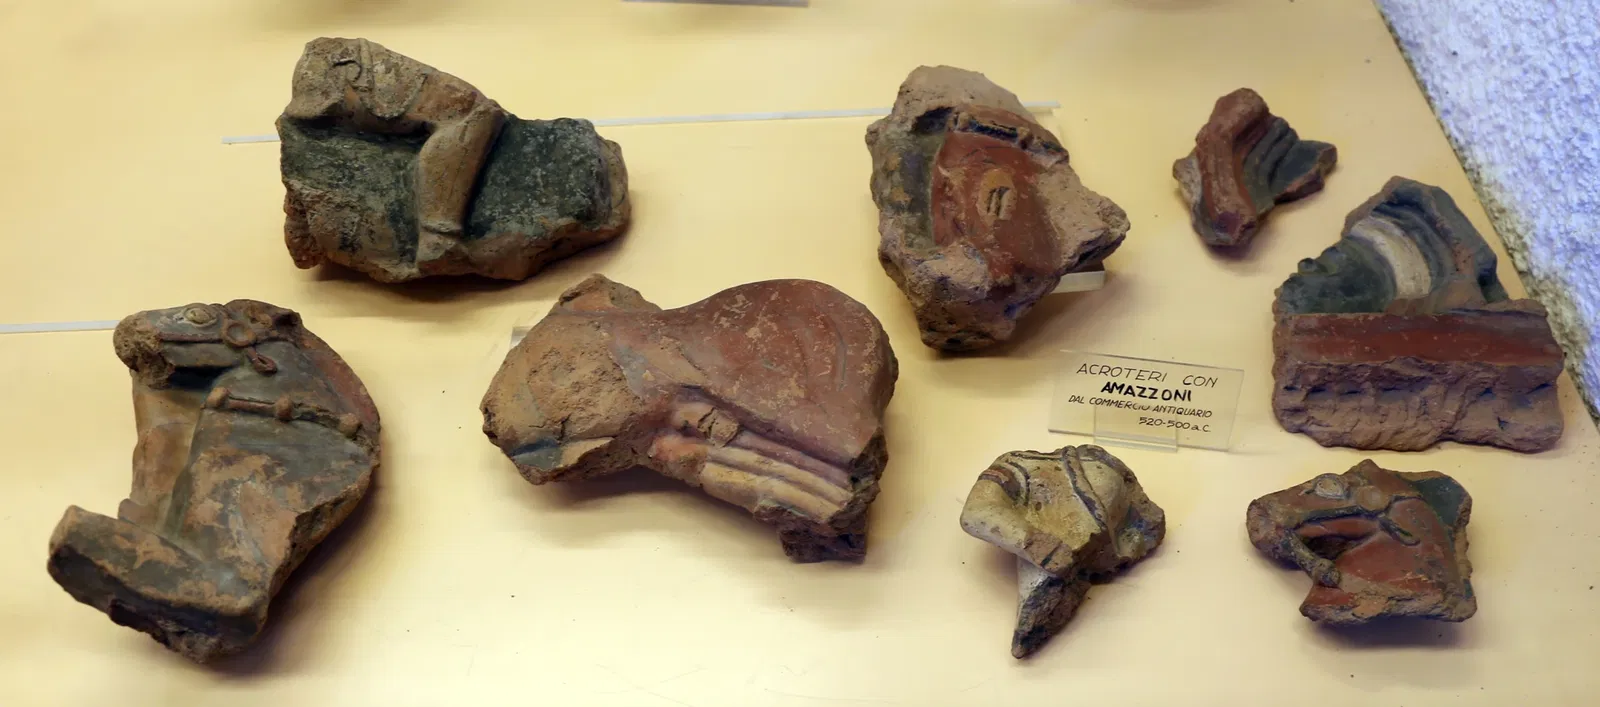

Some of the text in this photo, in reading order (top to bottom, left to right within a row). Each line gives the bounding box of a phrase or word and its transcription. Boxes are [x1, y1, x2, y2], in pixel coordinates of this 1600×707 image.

[1076, 363, 1218, 388] ACROTERI CON
[1100, 381, 1192, 402] AMAZZONI
[1068, 395, 1085, 405] DAL
[1152, 405, 1212, 418] ANTIQUARIO
